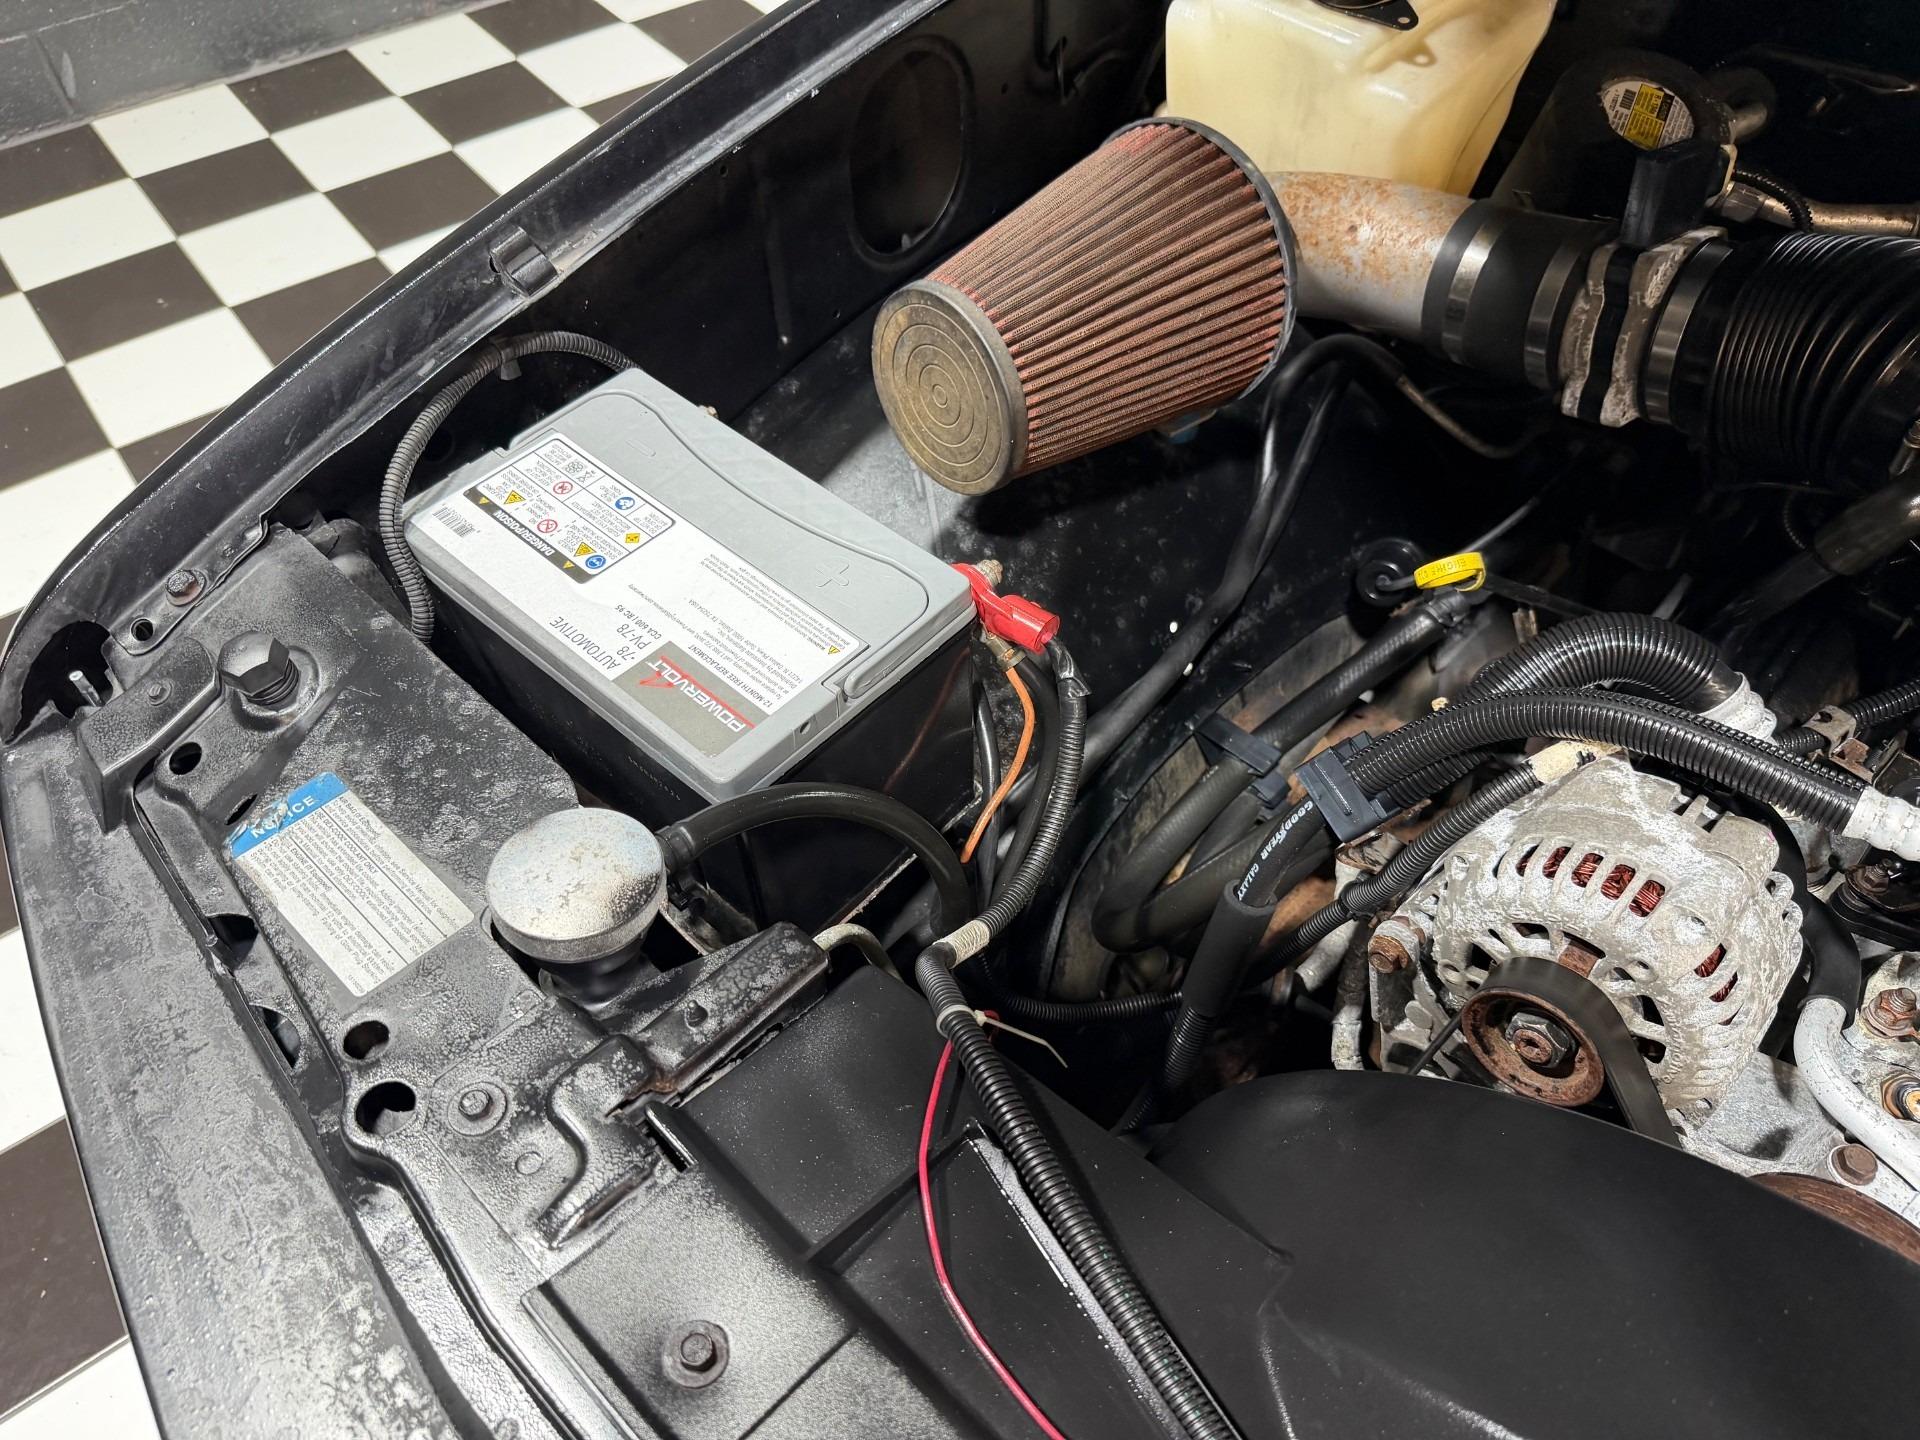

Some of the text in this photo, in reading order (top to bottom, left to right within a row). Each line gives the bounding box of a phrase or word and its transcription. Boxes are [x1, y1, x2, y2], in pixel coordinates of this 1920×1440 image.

[492, 509, 555, 555] DANGER/POISON
[622, 609, 635, 618] RC
[634, 618, 649, 629] 600
[646, 627, 662, 639] CCA
[549, 616, 621, 670] AUTOMOTIVE
[615, 623, 651, 649] PV-78
[648, 658, 746, 732] POWERVOLT
[687, 644, 773, 707] 12-MONTH FREE REPLACEMENT
[251, 795, 317, 839] NOICE
[289, 847, 308, 865] ENGINE
[309, 869, 332, 891] Equipped)
[343, 840, 366, 862] COOLANT
[363, 861, 377, 874] ONLY
[1237, 800, 1314, 901] GOODYEAR GALAXY
